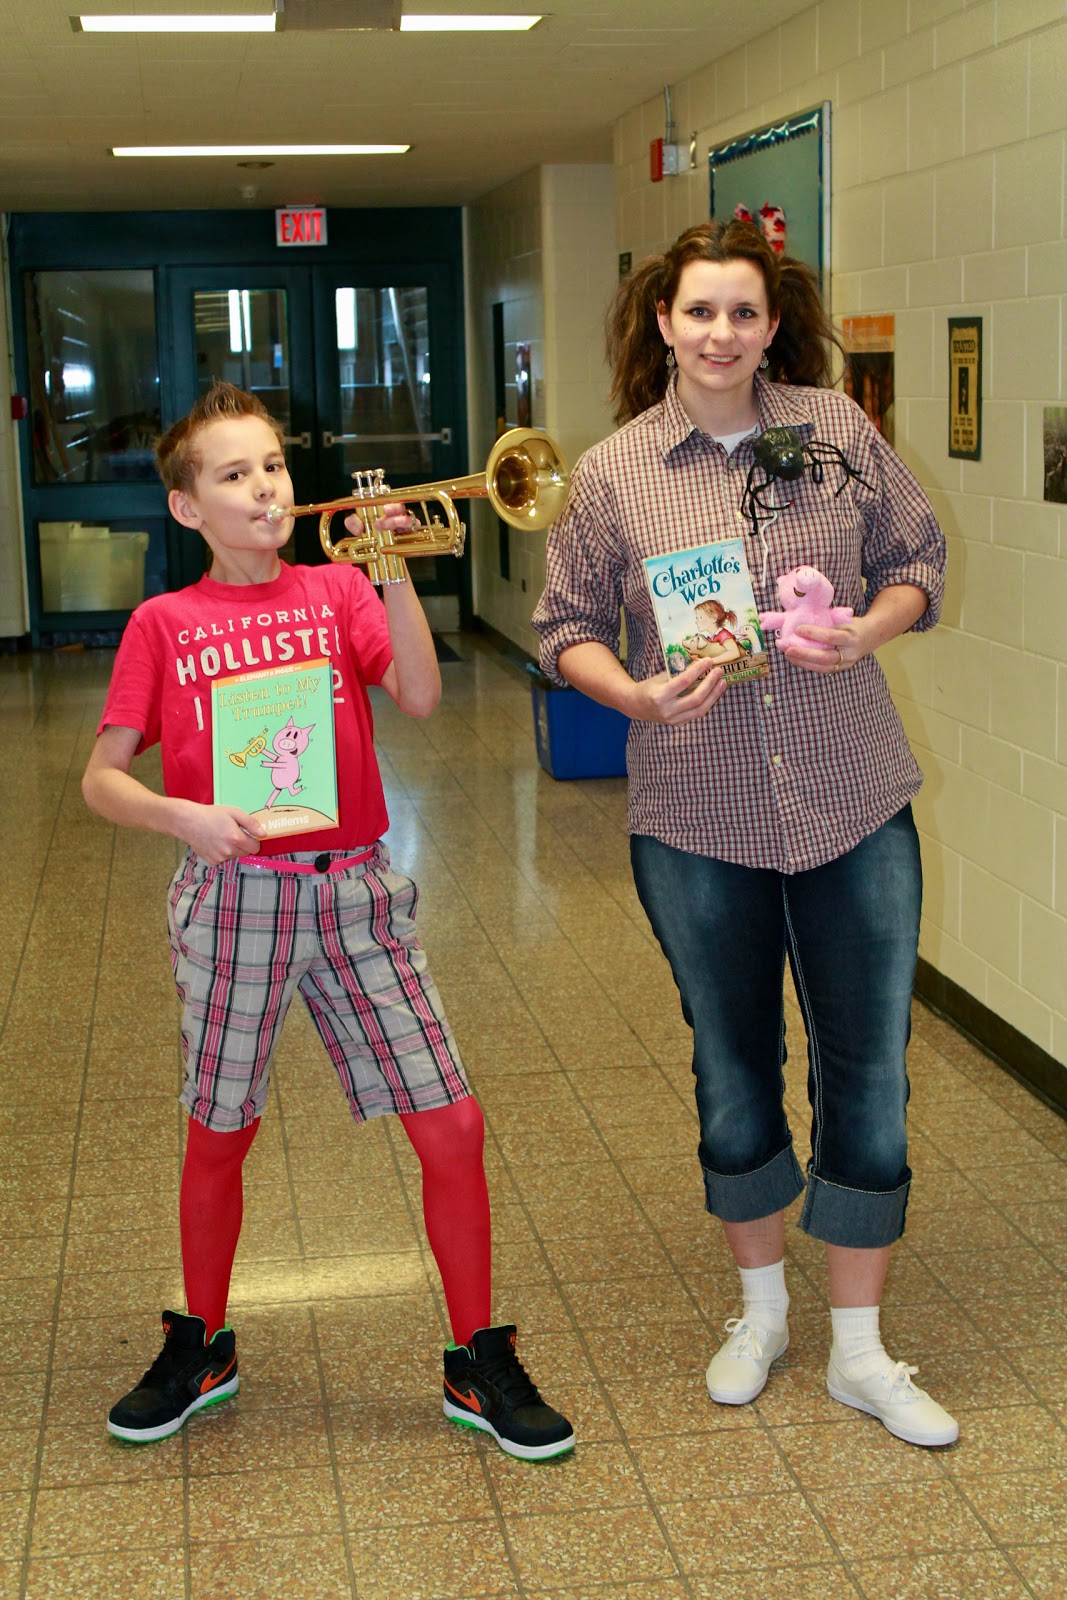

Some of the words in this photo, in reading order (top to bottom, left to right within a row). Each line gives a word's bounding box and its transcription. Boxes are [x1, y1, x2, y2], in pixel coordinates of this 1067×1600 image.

[280, 211, 323, 242] EXIT
[652, 554, 740, 598] Charlotte's
[680, 574, 721, 606] Web
[177, 604, 335, 645] CALIFORNIA
[176, 625, 342, 686] HOLLISTE
[720, 659, 750, 674] HITE
[219, 686, 270, 707] Listen
[275, 682, 291, 696] to
[296, 676, 321, 693] My
[231, 694, 308, 721] Trumpet!
[268, 815, 310, 829] Willems
